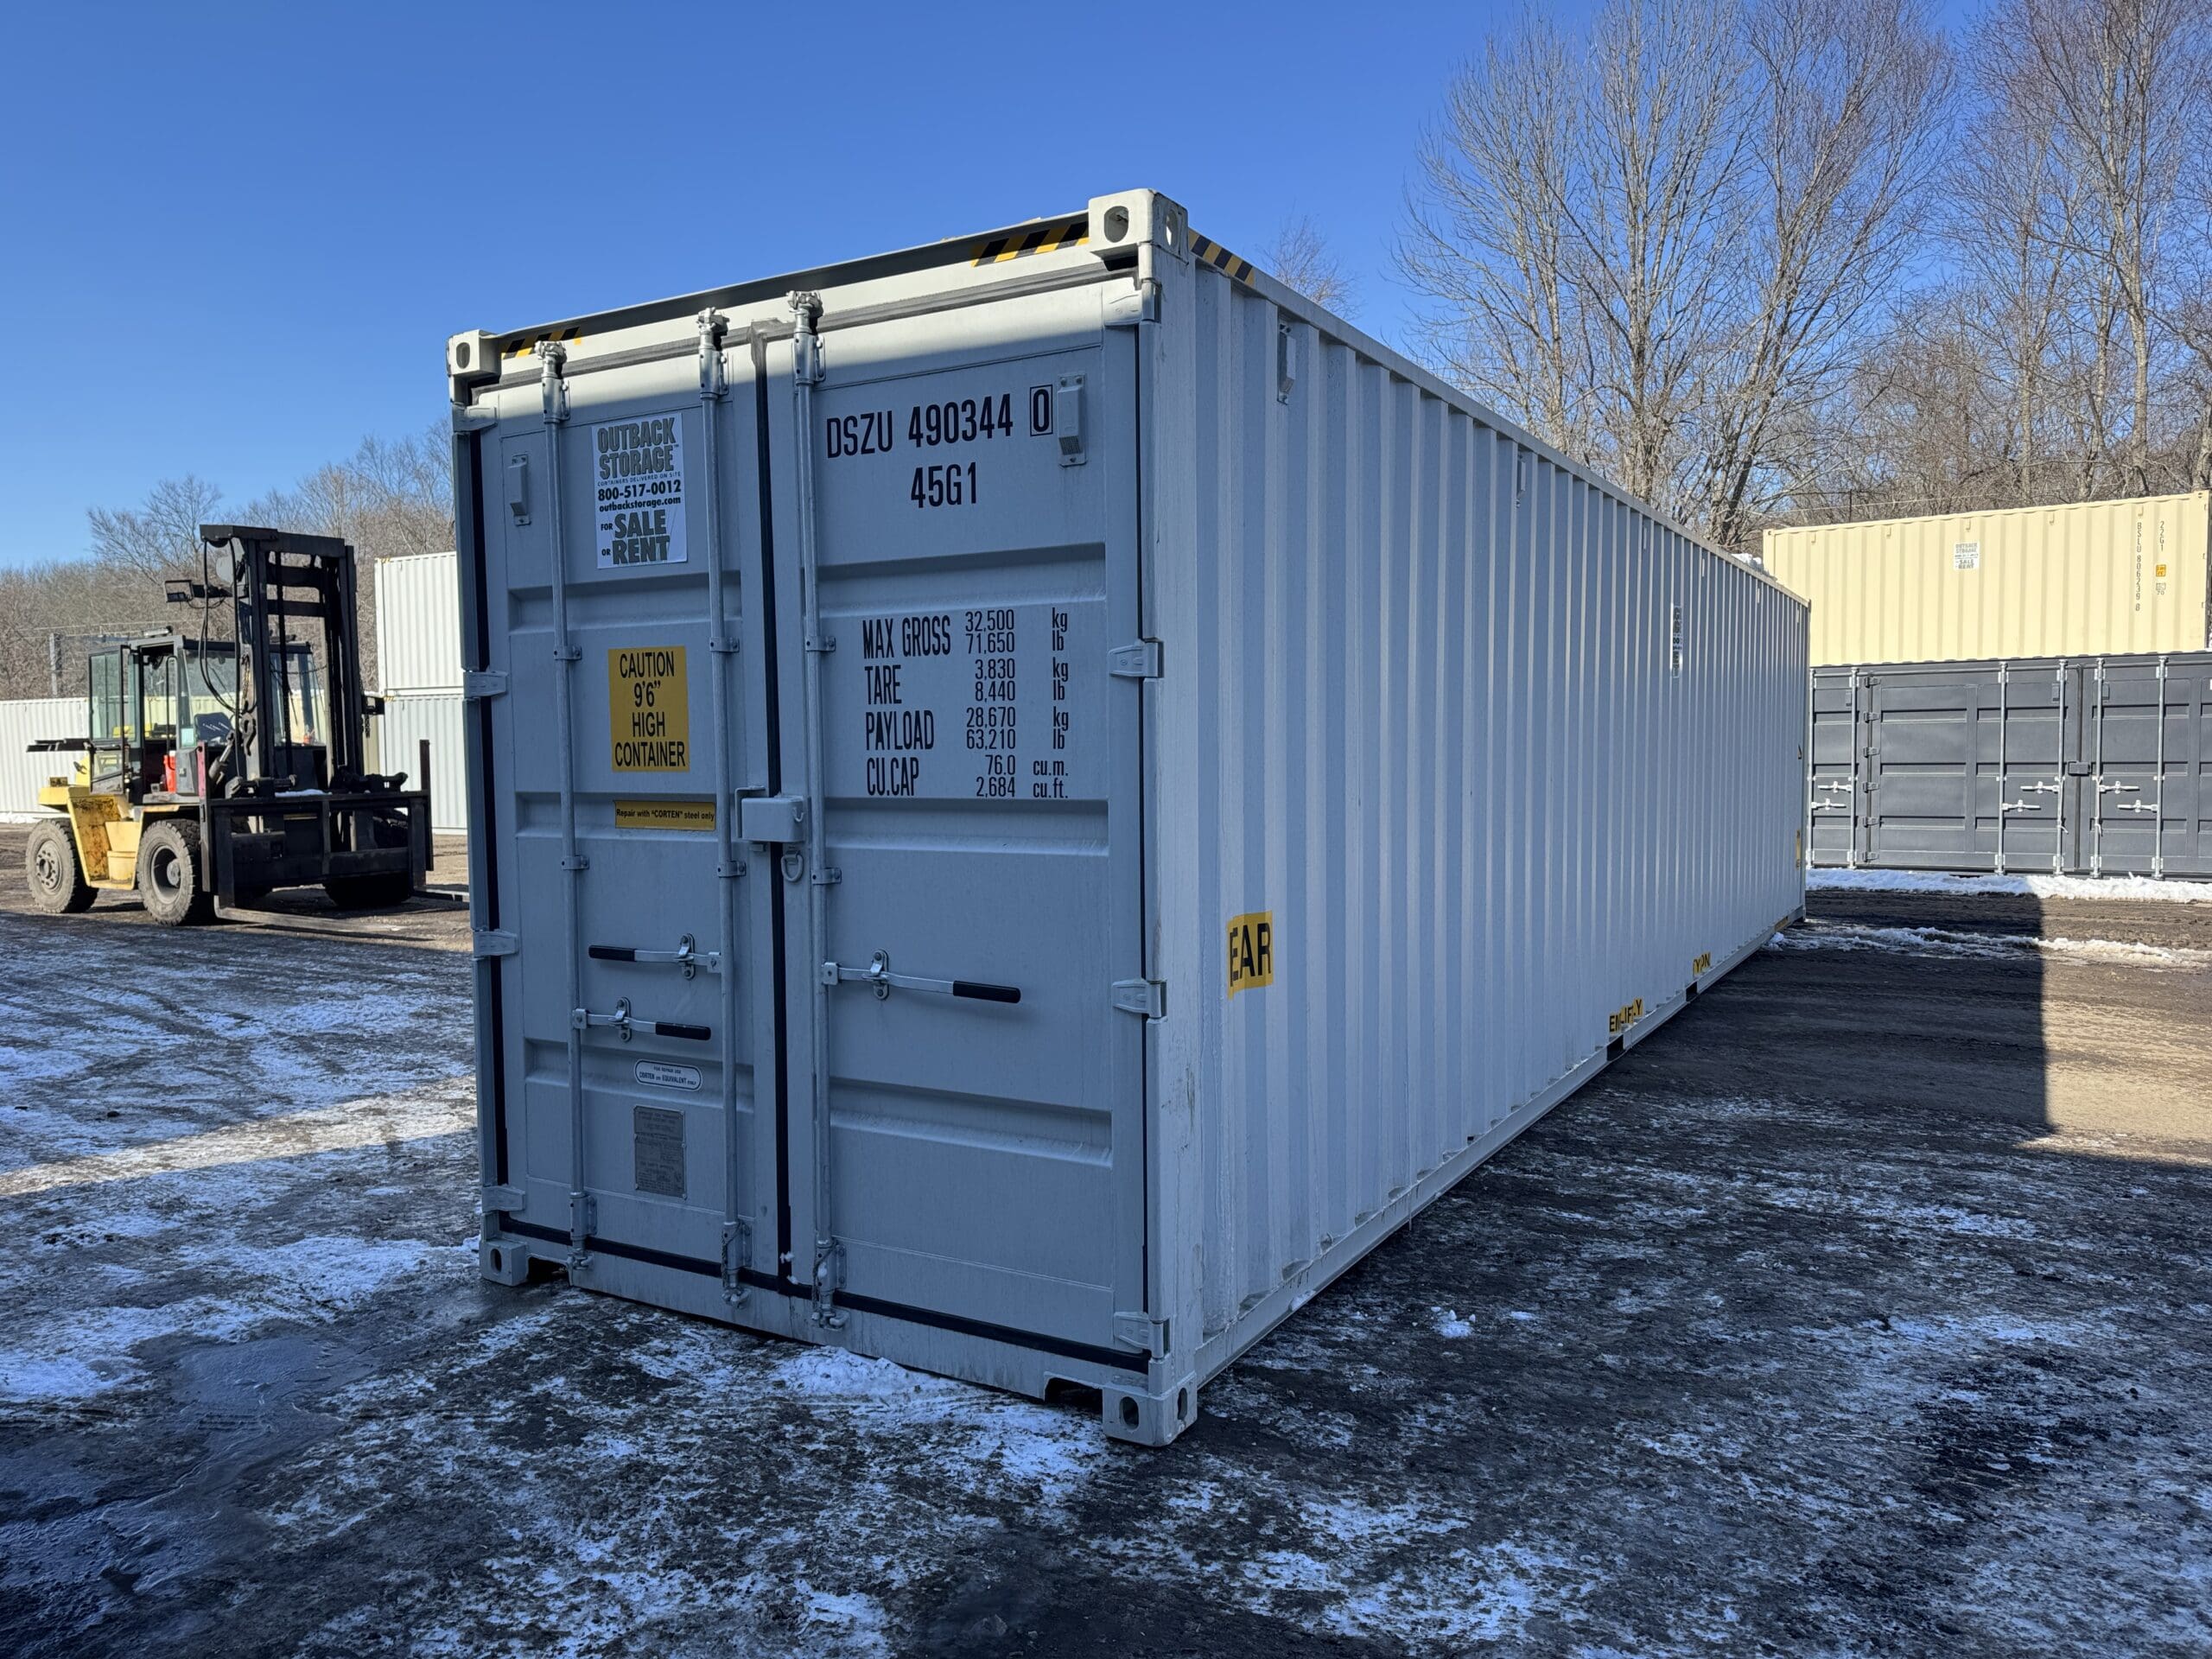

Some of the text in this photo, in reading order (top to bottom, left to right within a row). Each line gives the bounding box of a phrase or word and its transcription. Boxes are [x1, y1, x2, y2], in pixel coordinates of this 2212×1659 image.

[597, 416, 676, 453] OUTBACK
[826, 389, 1050, 459] DSZU 490344 0
[599, 445, 674, 480] STORAGE
[598, 478, 628, 486] CONTAINERS
[630, 474, 658, 483] DELIVERED
[598, 480, 681, 501] 800-517-0012
[911, 461, 976, 508] 45G1
[599, 497, 681, 512] outbackstorage.com
[614, 509, 667, 539] SALE
[612, 536, 671, 564] RENT
[862, 607, 1068, 659] MAX GROSS 32,500 kg
[967, 630, 1065, 654] 71,650 lb
[620, 651, 675, 678] CAUTION
[864, 657, 1069, 705] TARE 3,830 kg
[975, 679, 1065, 702] 8,440 lb
[632, 711, 665, 737] HIGH
[865, 706, 1069, 751] PAYLOAD 28,670 kg
[966, 728, 1065, 750] 63,210 lb
[615, 741, 686, 767] CONTAINER
[867, 754, 1069, 796] CU.CAP 76.0 cu.m.
[976, 777, 1069, 798] 2,684 cu.ft.
[616, 809, 635, 818] Repair
[701, 811, 715, 822] only
[662, 1074, 687, 1084] EQUIVALENT
